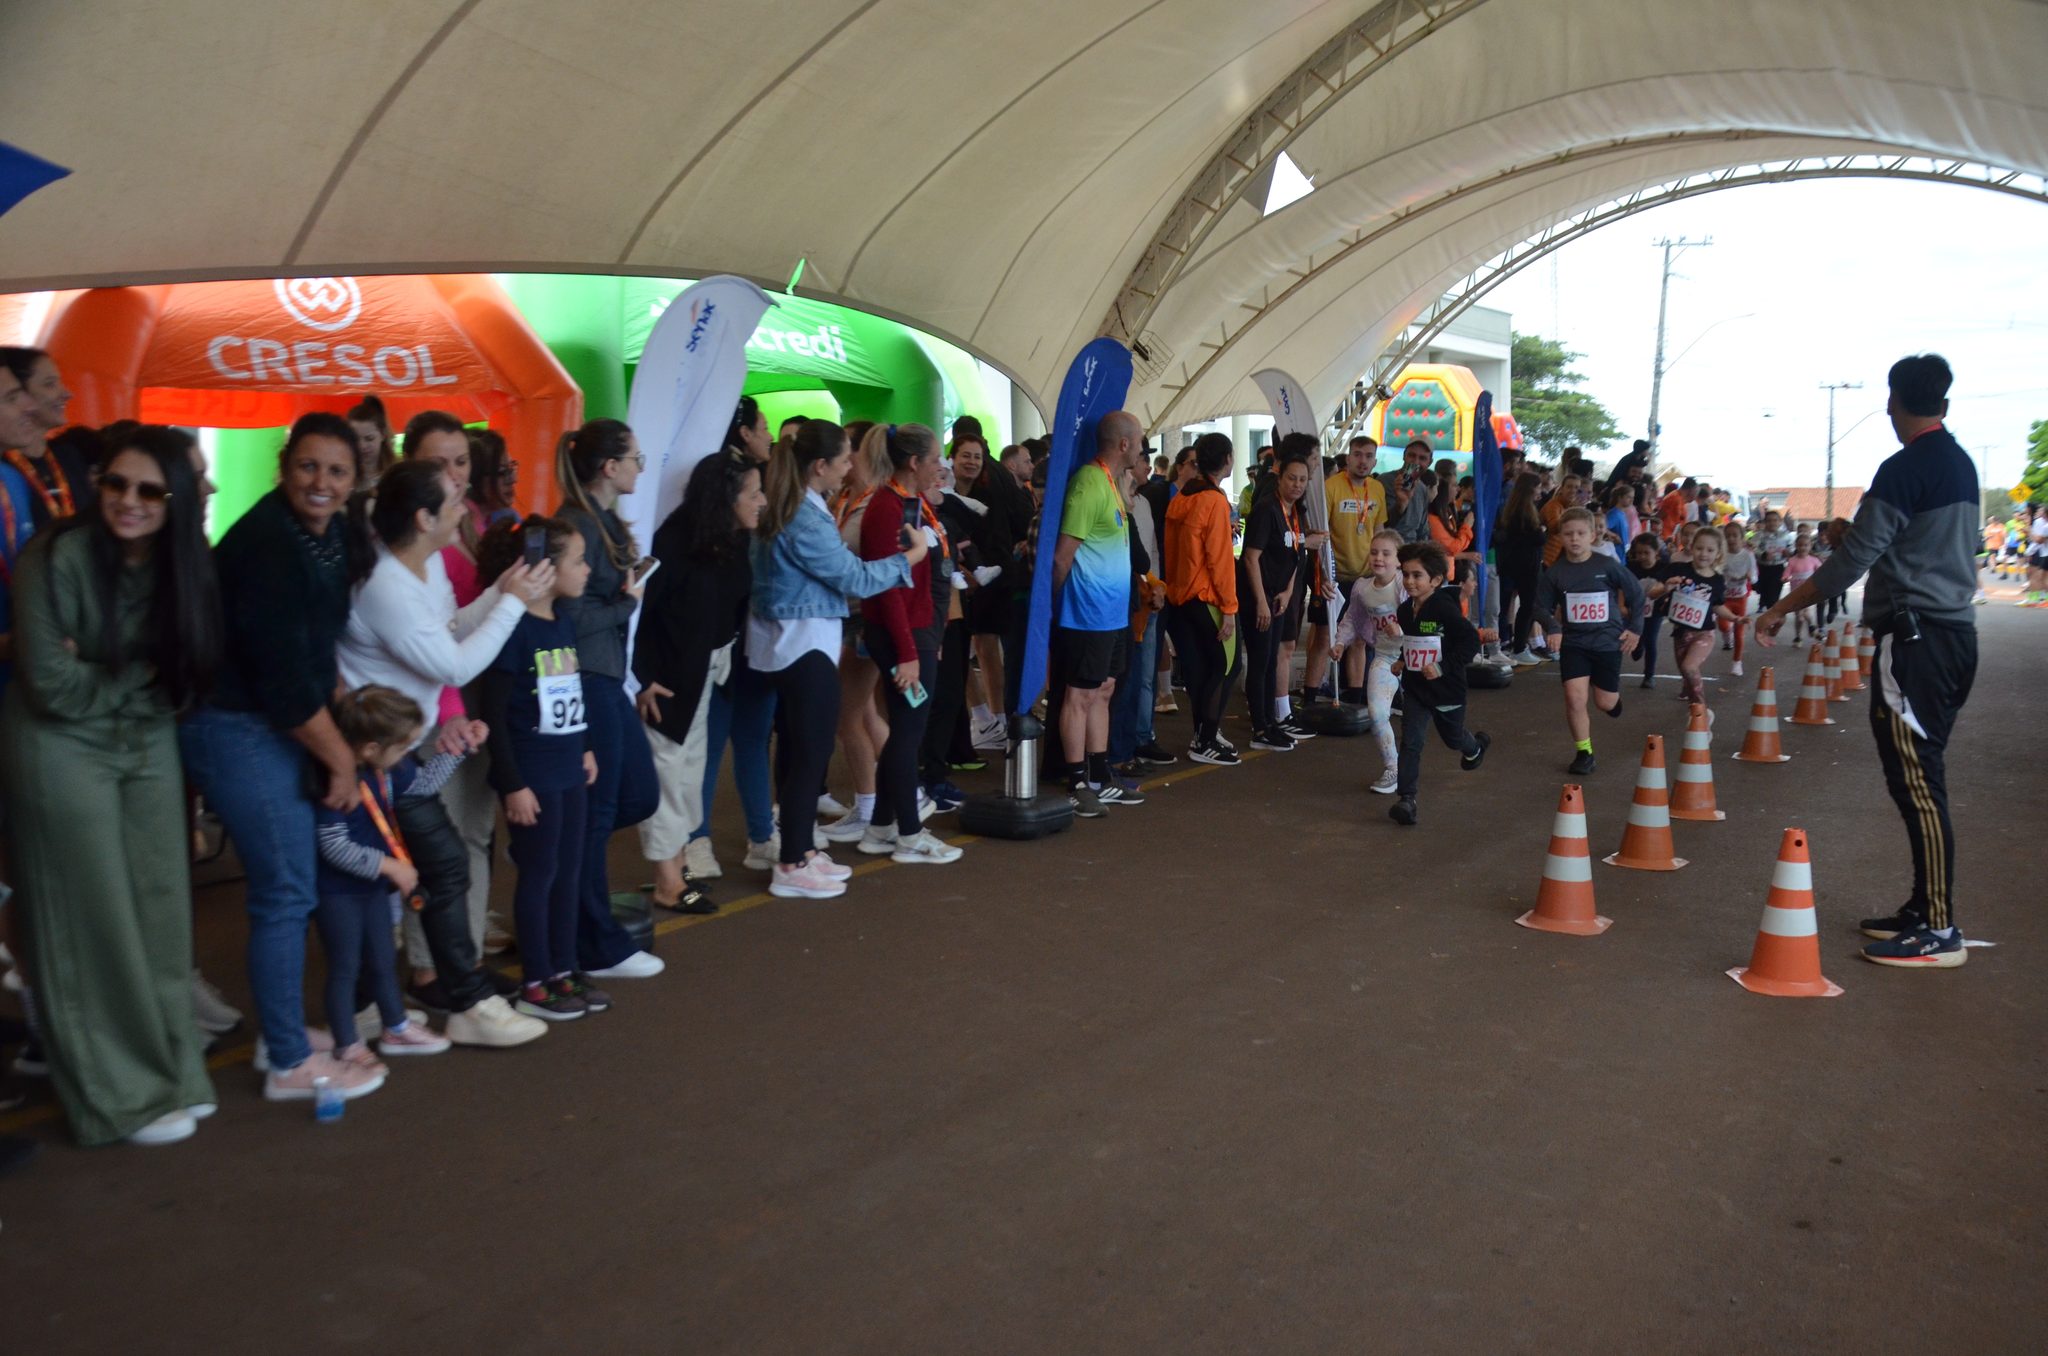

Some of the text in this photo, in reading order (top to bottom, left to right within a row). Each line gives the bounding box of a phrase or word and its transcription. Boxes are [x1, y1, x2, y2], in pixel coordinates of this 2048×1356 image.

[744, 325, 848, 364] credi
[207, 335, 459, 387] CRESOL
[1571, 603, 1606, 621] 1265
[1671, 602, 1703, 625] 1269
[1405, 649, 1438, 668] 1277
